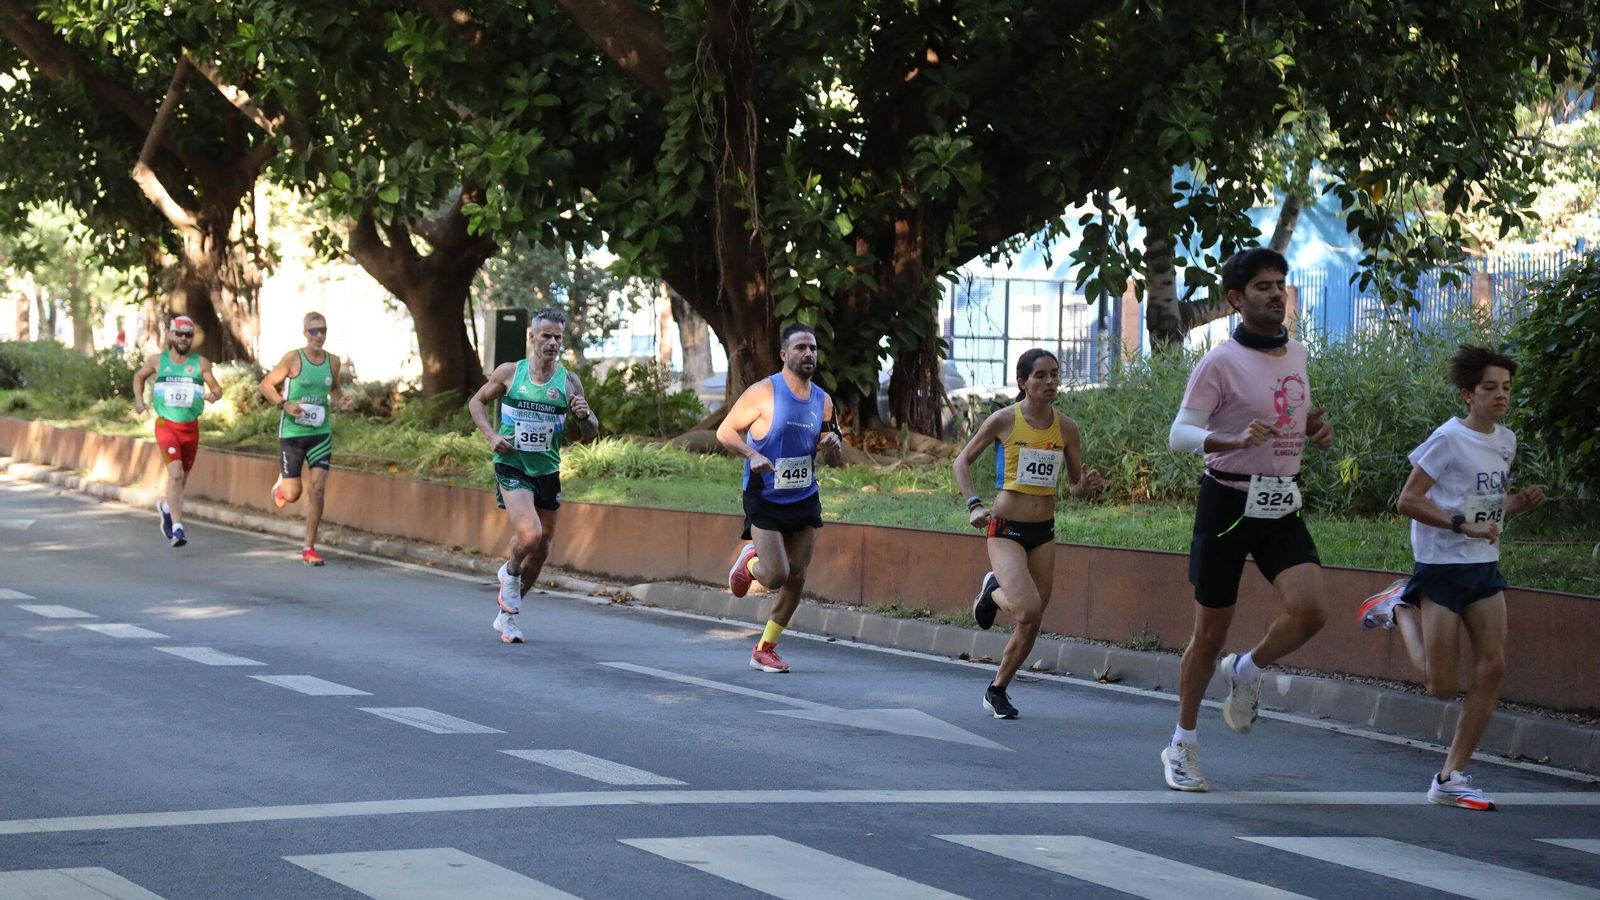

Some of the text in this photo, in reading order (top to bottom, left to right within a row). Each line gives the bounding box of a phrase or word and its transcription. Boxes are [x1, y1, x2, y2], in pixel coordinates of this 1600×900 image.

[170, 393, 188, 401] 107
[518, 400, 556, 413] ATLETISMO
[520, 432, 547, 443] 365
[782, 467, 808, 480] 448
[1026, 462, 1054, 476] 409
[1256, 491, 1295, 506] 324
